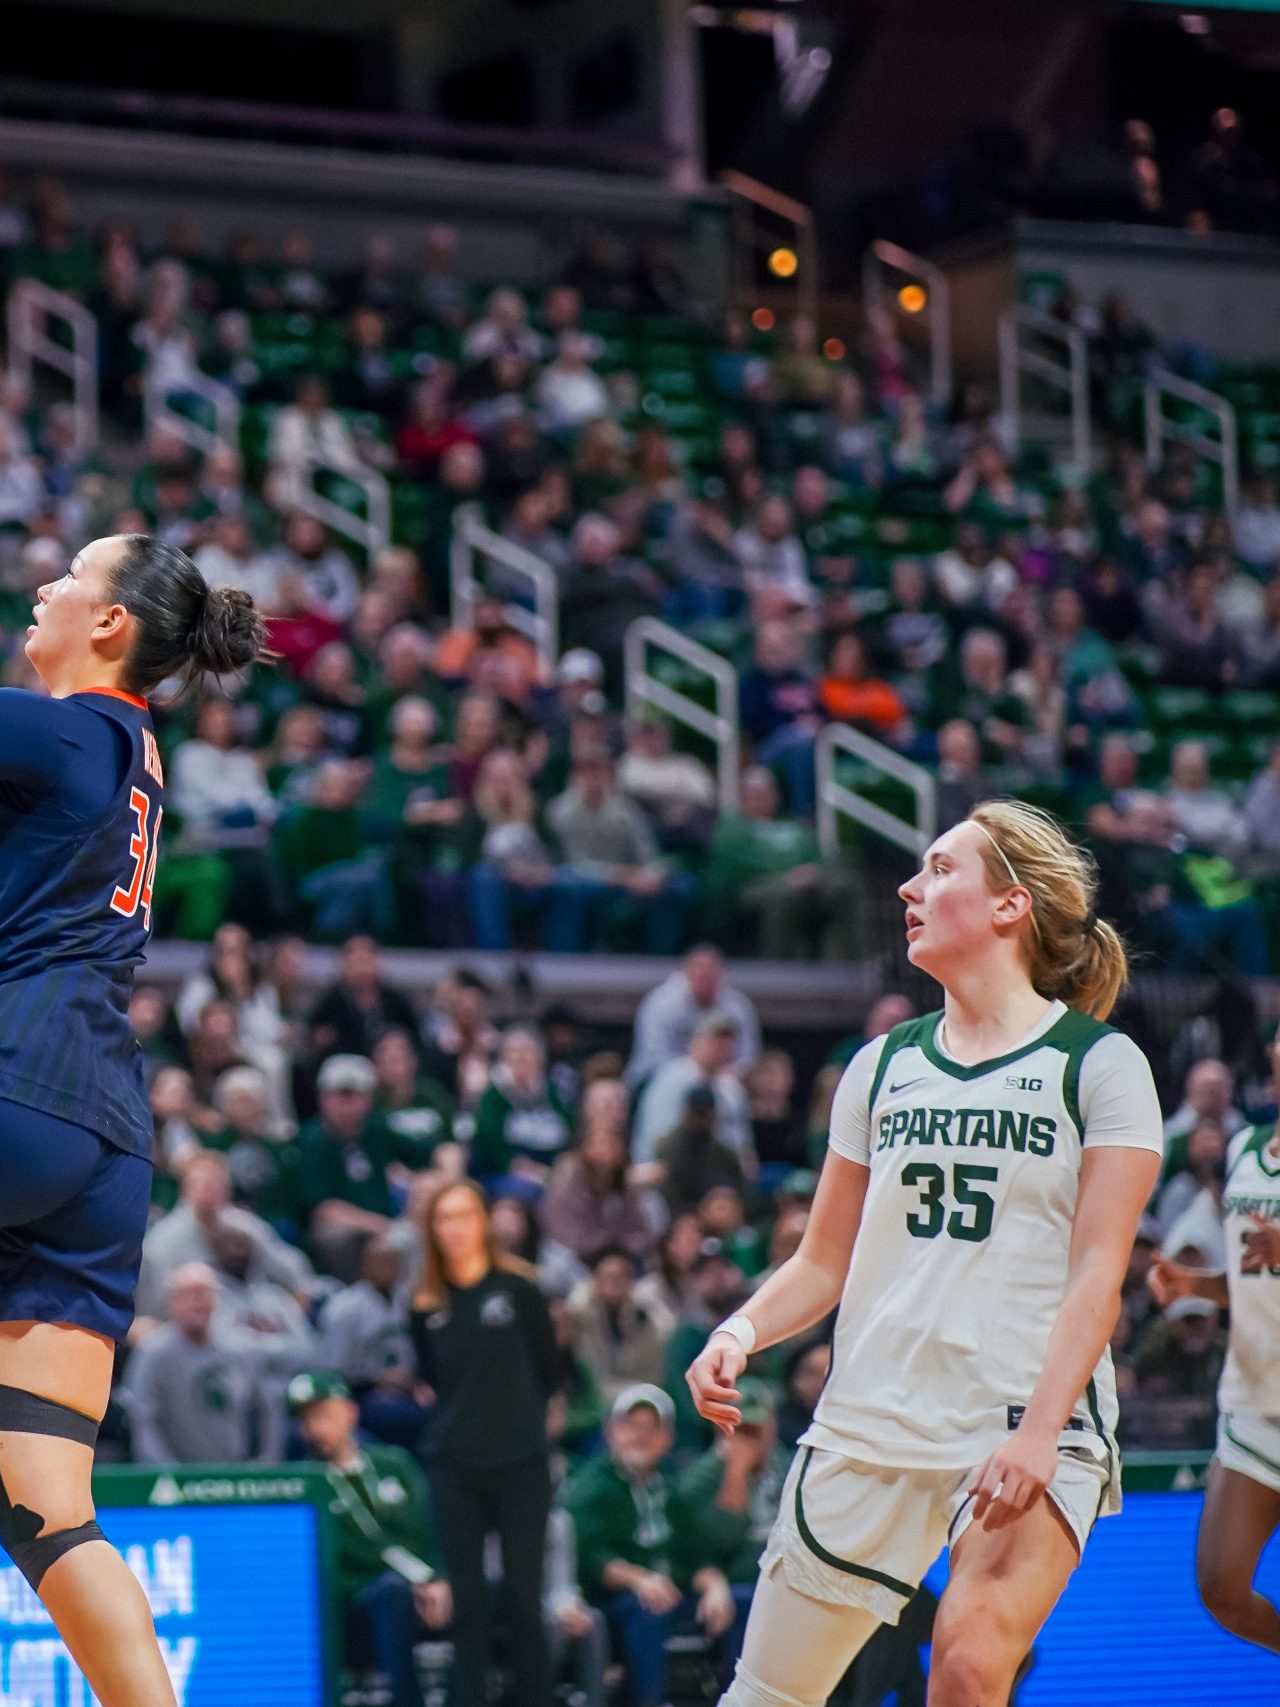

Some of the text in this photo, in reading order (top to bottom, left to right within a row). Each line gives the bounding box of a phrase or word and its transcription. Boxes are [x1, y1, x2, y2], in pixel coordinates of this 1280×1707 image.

[110, 786, 163, 931] 34
[877, 1108, 1057, 1157] SPARTANS
[901, 1162, 998, 1242] 35
